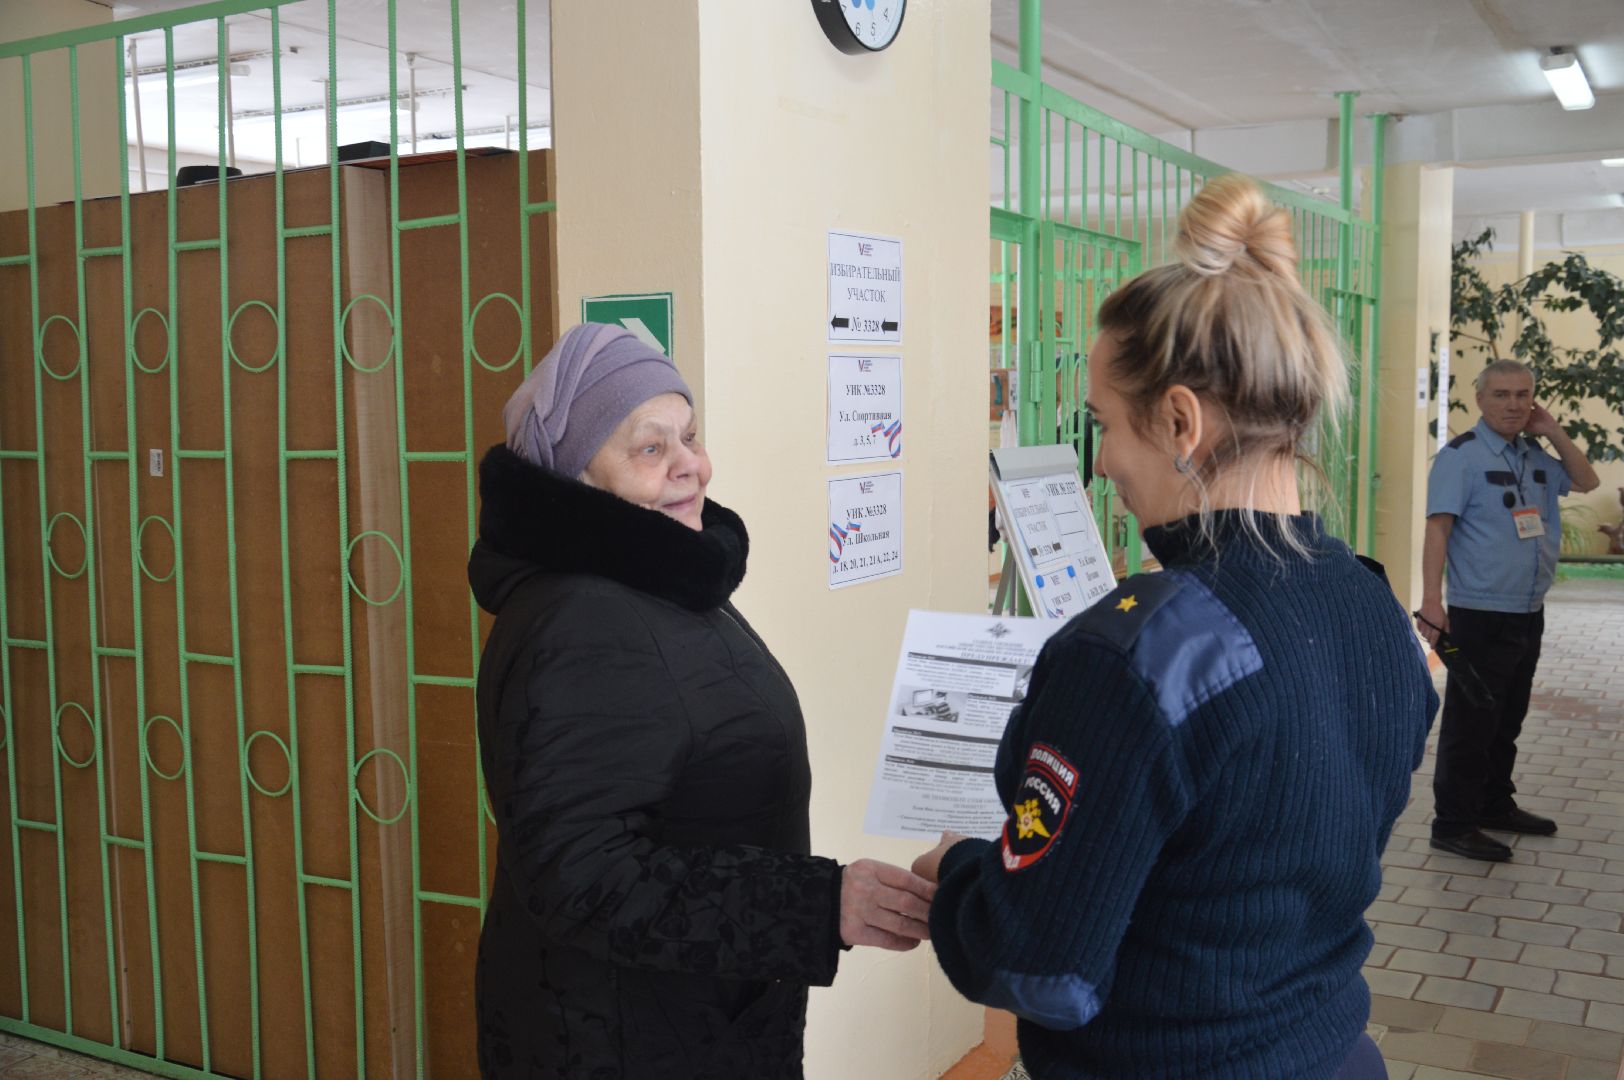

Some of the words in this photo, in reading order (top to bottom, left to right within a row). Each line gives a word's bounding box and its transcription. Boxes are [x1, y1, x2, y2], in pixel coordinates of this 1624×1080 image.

[883, 7, 889, 21] 4
[855, 22, 861, 36] 6
[870, 22, 876, 36] 5
[830, 263, 901, 282] ИЗБИРАТЕЛЬНЫЙ
[847, 287, 886, 303] УЧАСТОК
[863, 319, 880, 333] 3328
[846, 384, 863, 396] УИК
[839, 411, 851, 422] Ул.
[852, 410, 892, 424] Спортивная
[846, 507, 864, 520] УИК
[855, 530, 890, 545] Школьная
[860, 557, 869, 568] 21,
[1030, 748, 1075, 787] ПОЛИЦИЯ
[1024, 776, 1061, 815] РОССИЯ
